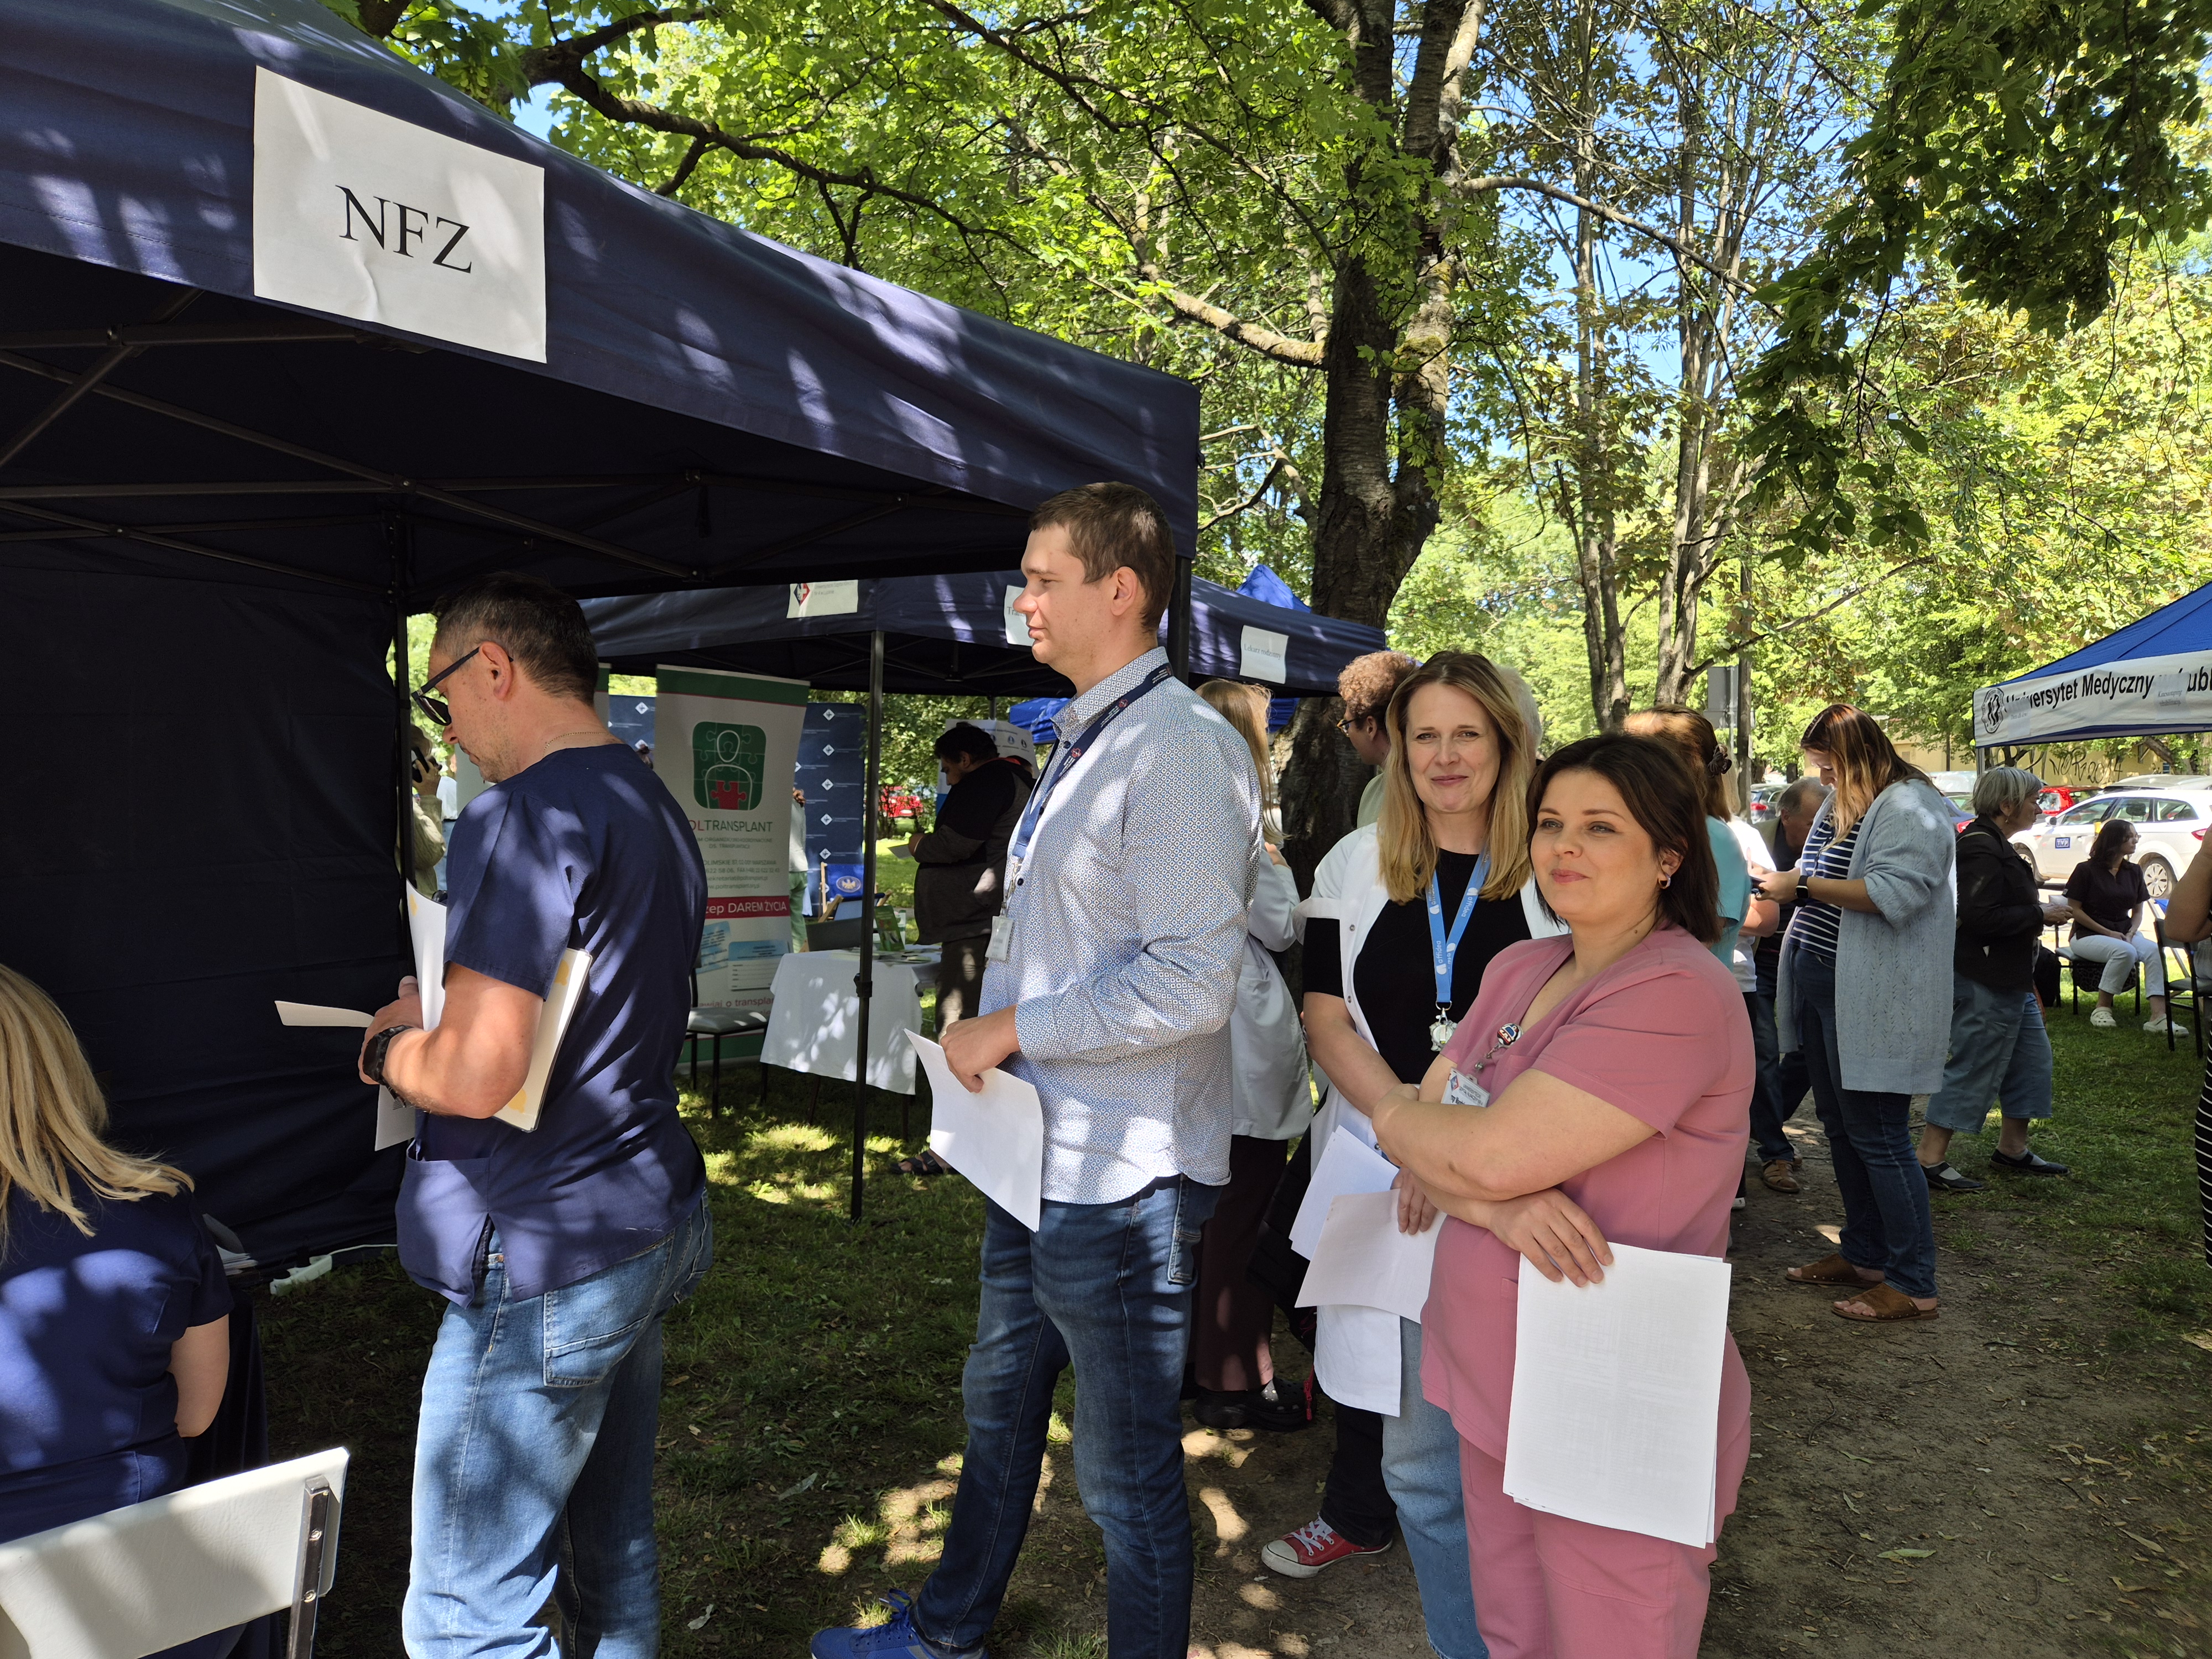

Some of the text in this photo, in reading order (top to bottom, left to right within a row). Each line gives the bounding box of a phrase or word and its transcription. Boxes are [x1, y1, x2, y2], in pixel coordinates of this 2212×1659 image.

[335, 185, 472, 274] NFZ
[1244, 644, 1282, 660] Lekarz rodzinny
[2082, 671, 2155, 700] Medyczny
[689, 820, 773, 832] OLTRANSPLANT
[2057, 838, 2069, 847] TVP
[728, 902, 764, 912] DAREM
[765, 900, 787, 911] ŻYCIA
[1461, 896, 1473, 917] affidea
